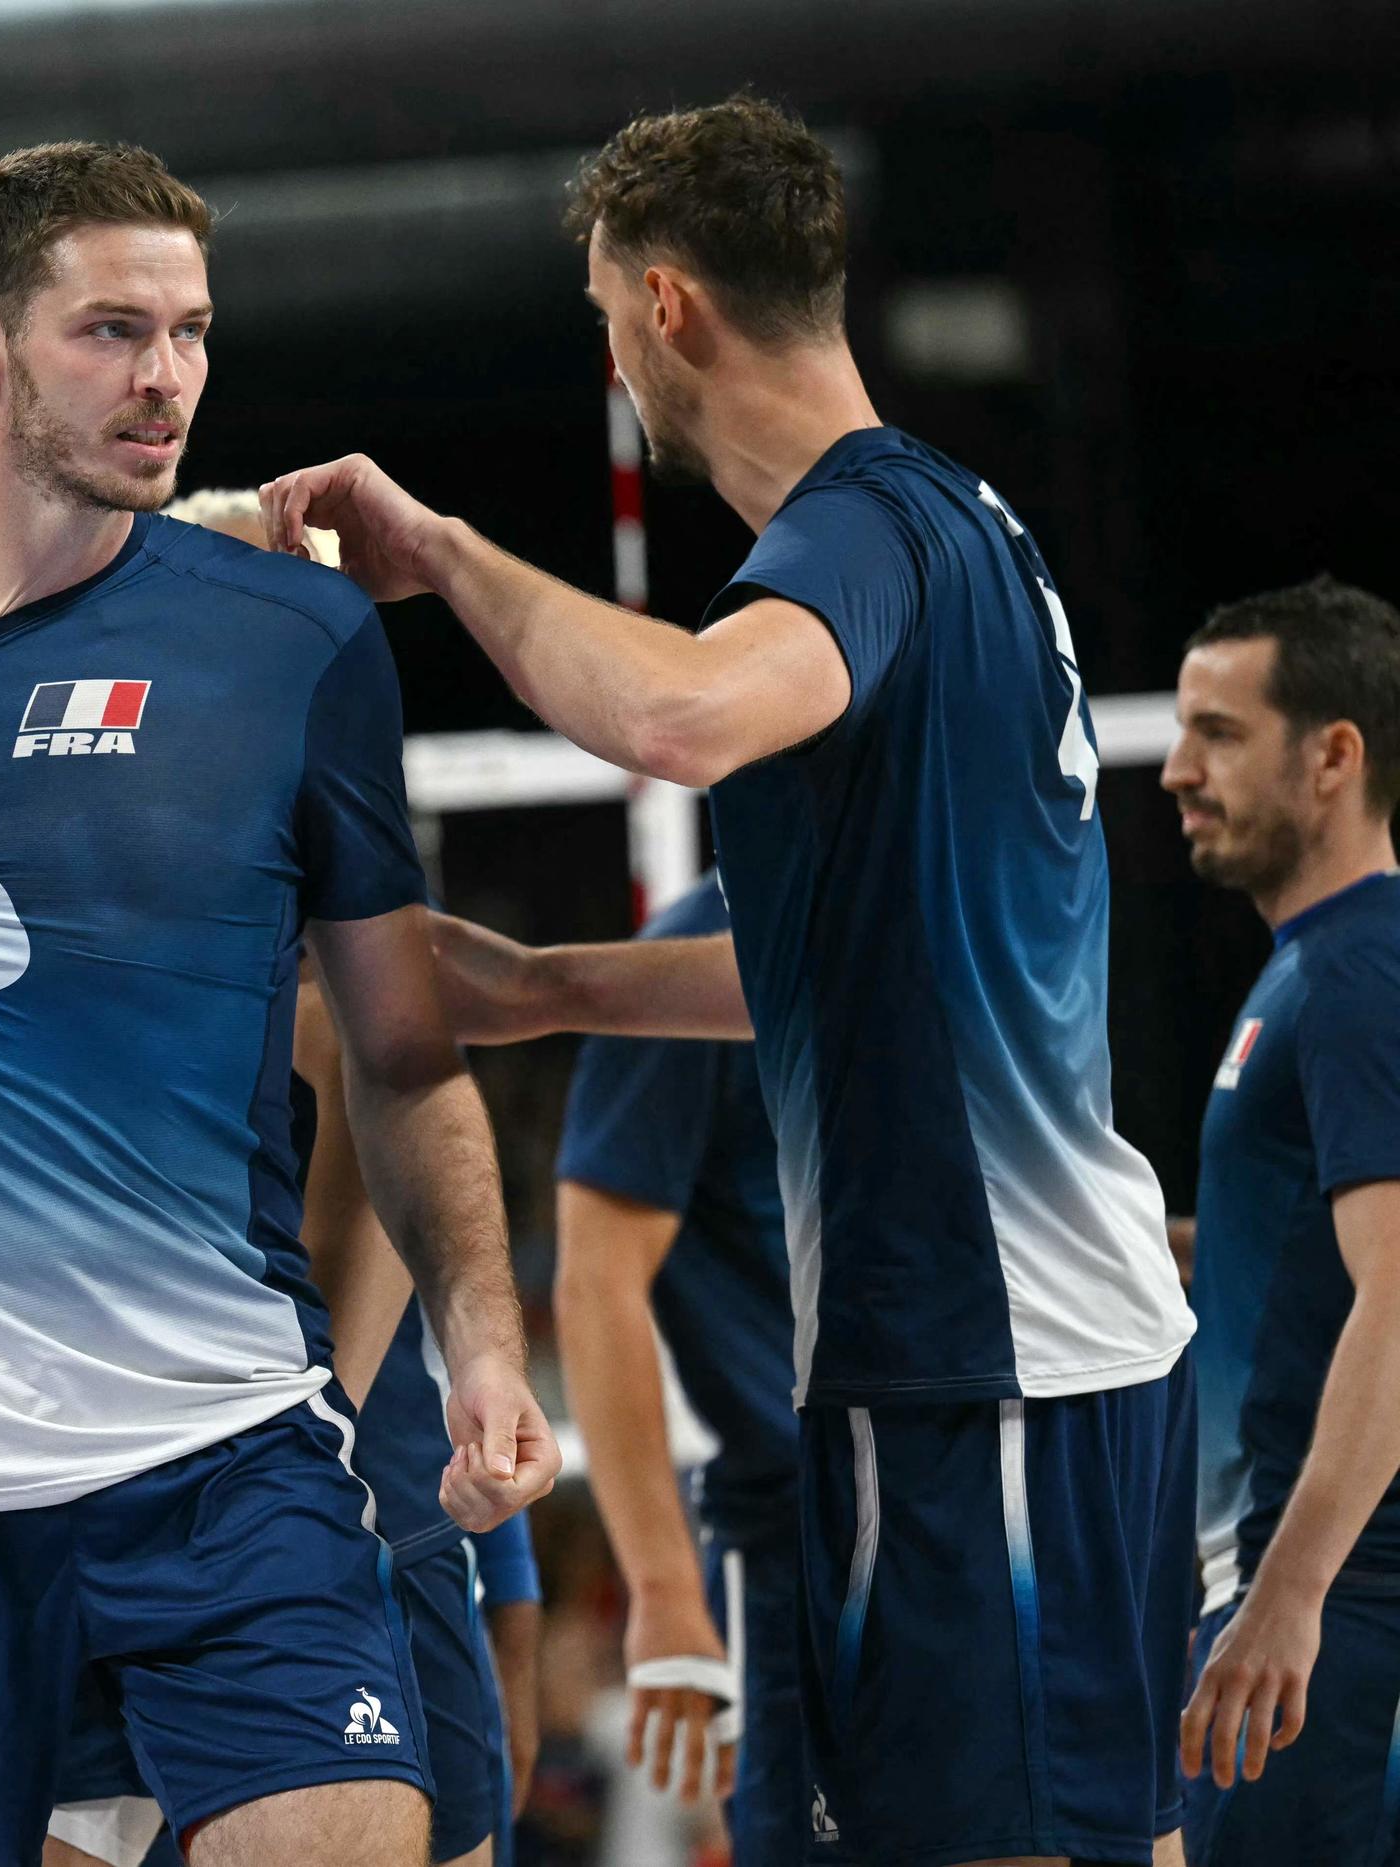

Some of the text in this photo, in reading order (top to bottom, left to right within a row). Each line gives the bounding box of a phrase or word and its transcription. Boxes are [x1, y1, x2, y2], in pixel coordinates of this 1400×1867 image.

[12, 732, 136, 758] FRA
[344, 1733, 401, 1745] LE COQ SPORTIF
